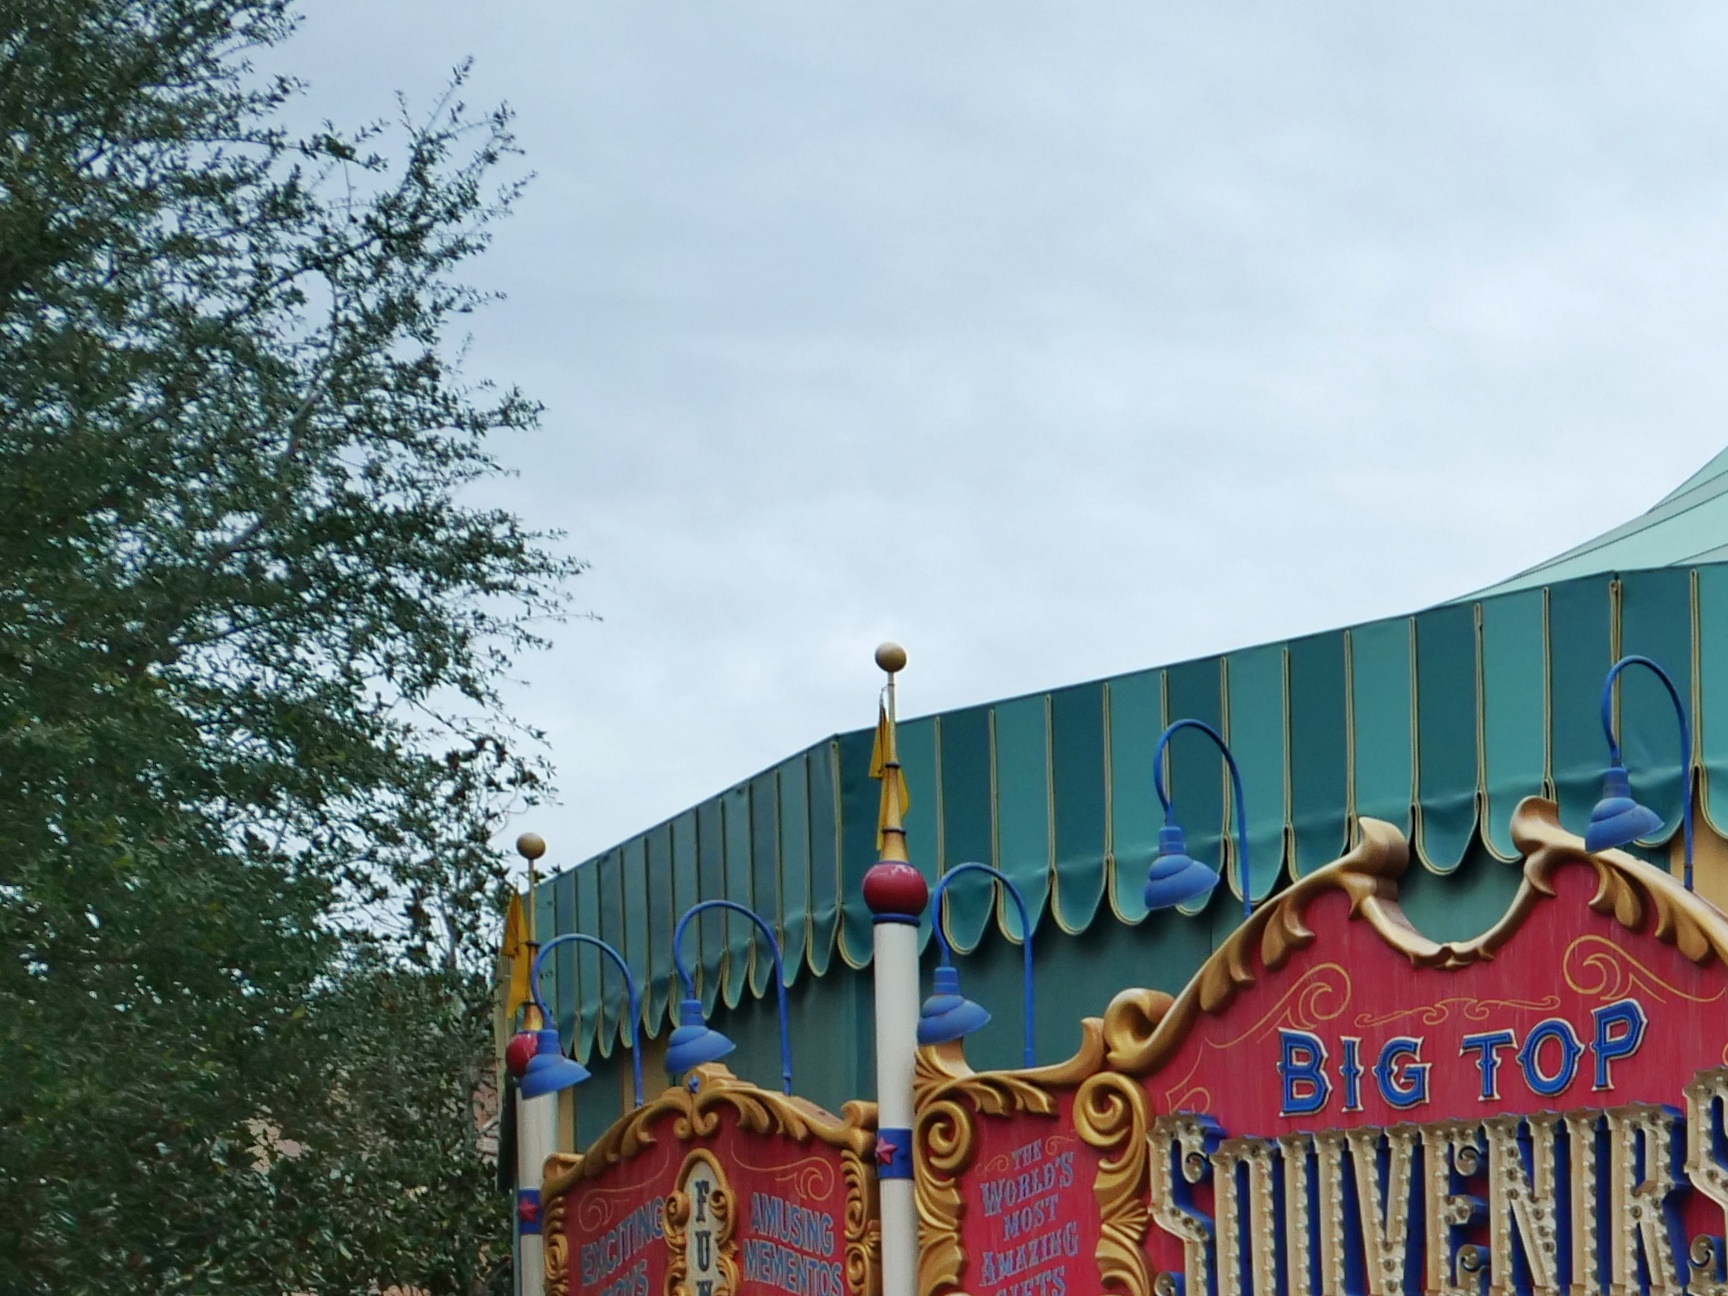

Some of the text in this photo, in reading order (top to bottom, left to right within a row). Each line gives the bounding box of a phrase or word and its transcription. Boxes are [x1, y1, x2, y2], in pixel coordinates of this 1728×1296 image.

[1277, 998, 1648, 1117] BIG TOP
[980, 1151, 1074, 1217] WORLD'S
[1012, 1138, 1043, 1171] THE
[580, 1196, 665, 1287] EXCITING
[749, 1191, 835, 1257] AMUSING
[1003, 1193, 1060, 1242] MOST
[979, 1221, 1079, 1287] AMAZING
